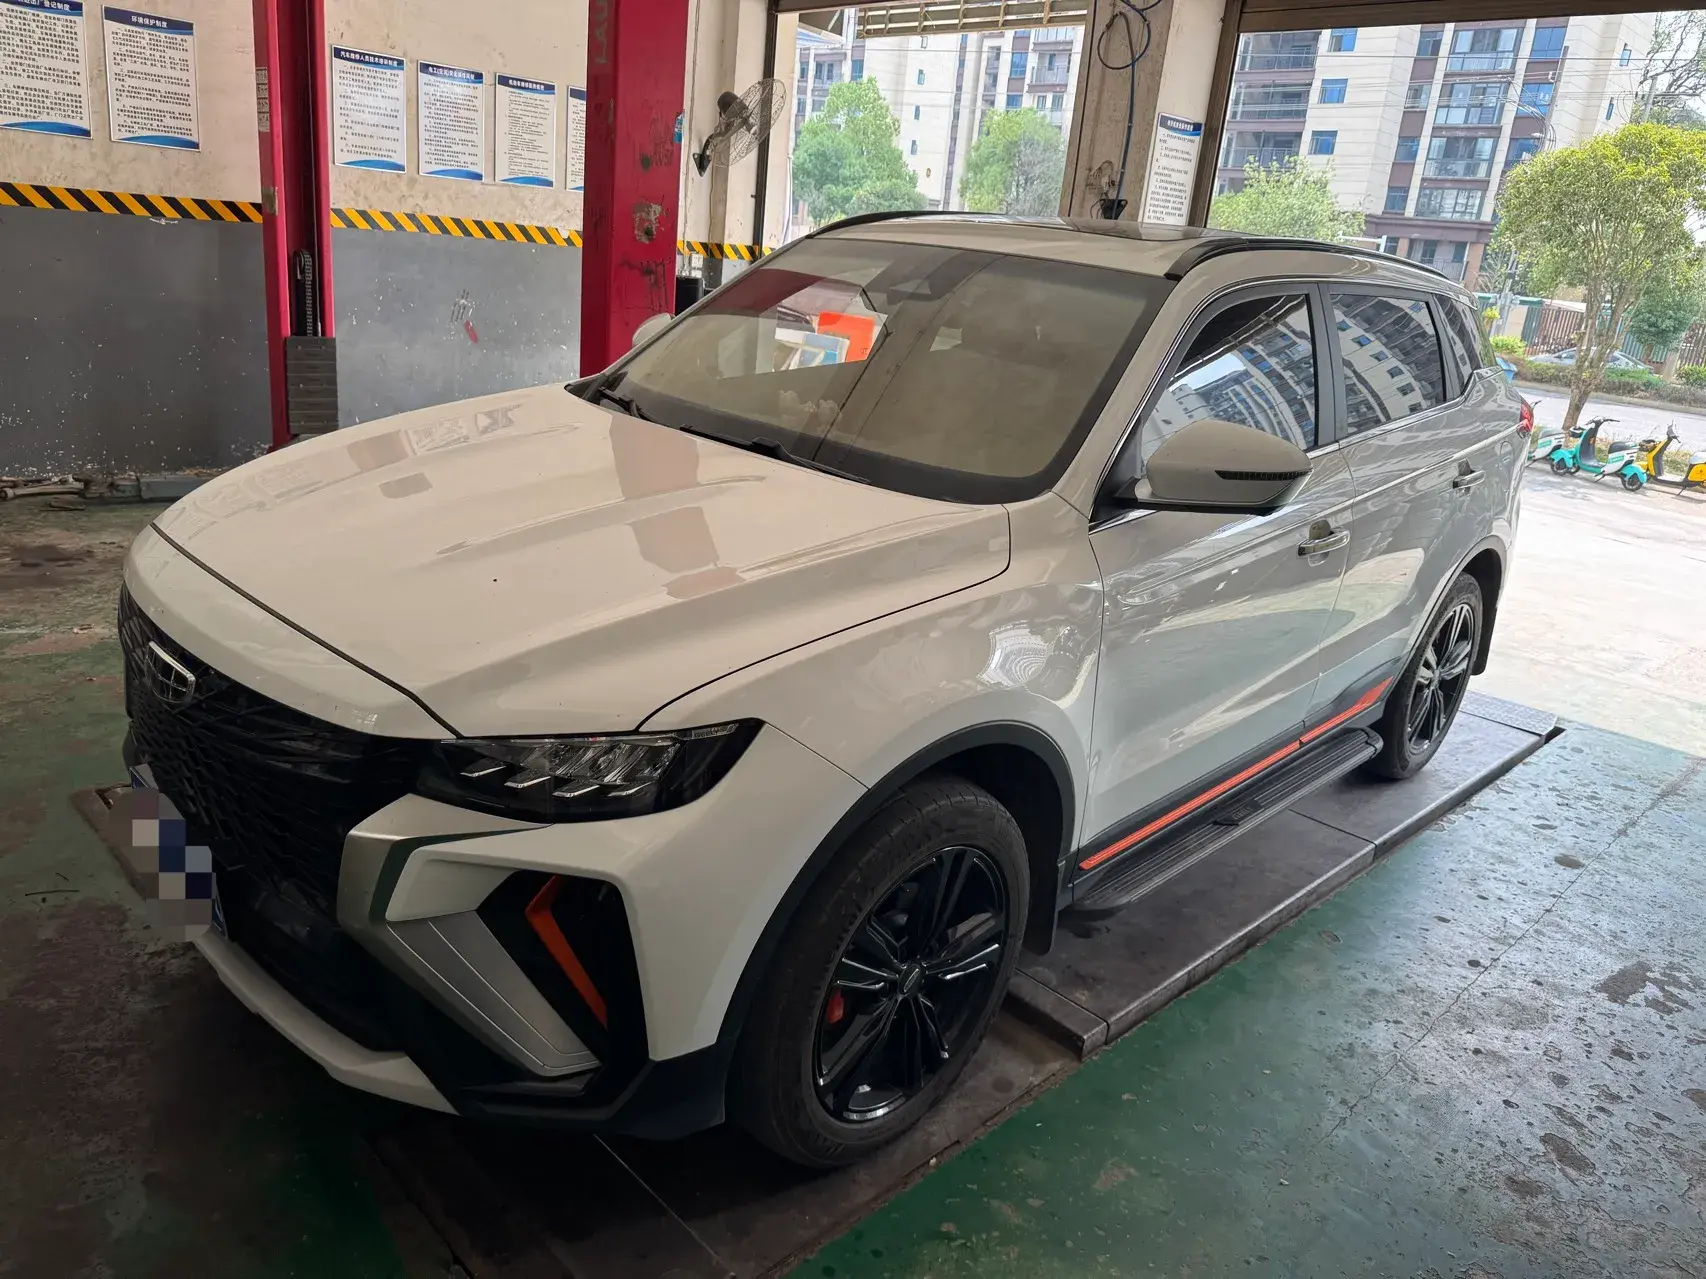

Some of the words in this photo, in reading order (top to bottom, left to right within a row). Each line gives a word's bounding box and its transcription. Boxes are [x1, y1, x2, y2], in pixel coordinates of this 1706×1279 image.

[131, 15, 168, 29] 环境保护制度
[340, 51, 398, 65] 汽车维修人员技术培训制度
